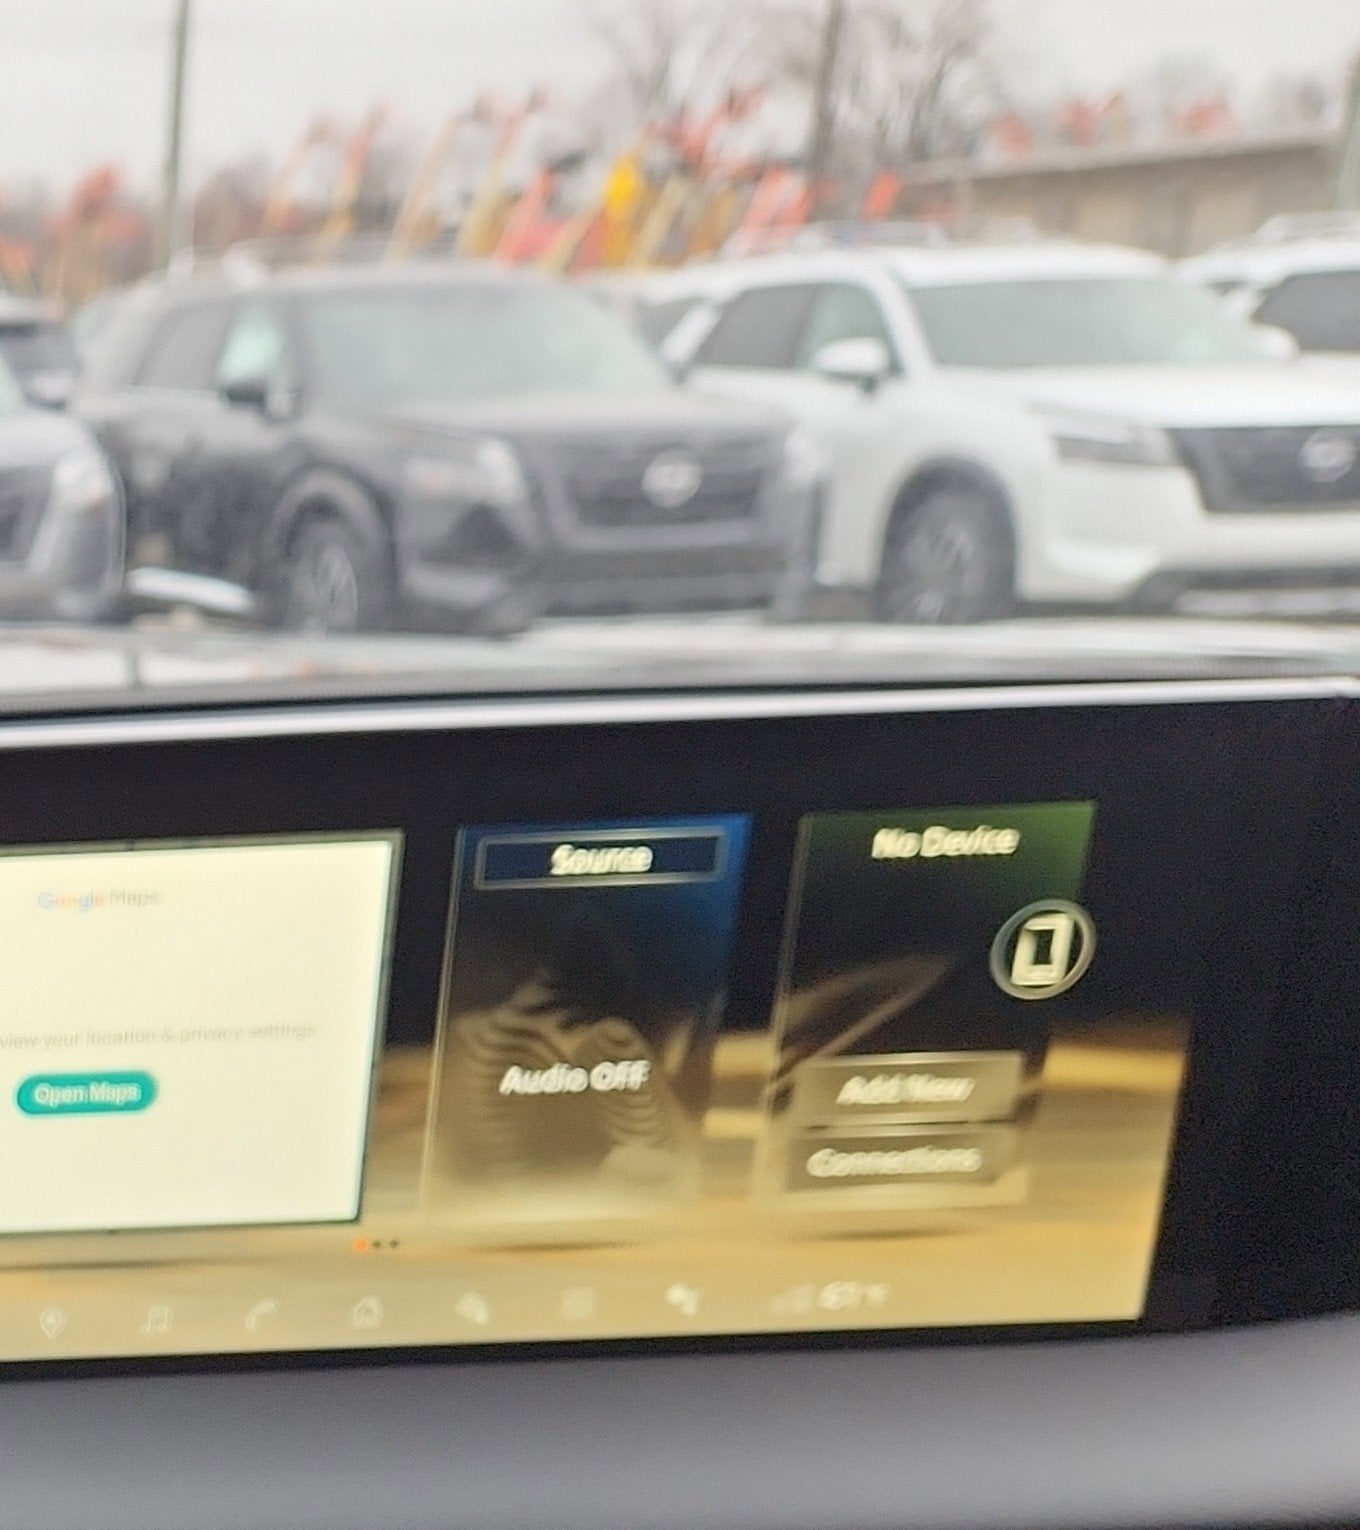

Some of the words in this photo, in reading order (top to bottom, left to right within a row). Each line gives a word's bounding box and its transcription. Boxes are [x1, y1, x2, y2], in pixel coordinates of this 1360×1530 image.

[920, 825, 1021, 857] Device
[33, 1083, 86, 1109] Open
[88, 1080, 142, 1106] Maps
[499, 1063, 589, 1096] Audio
